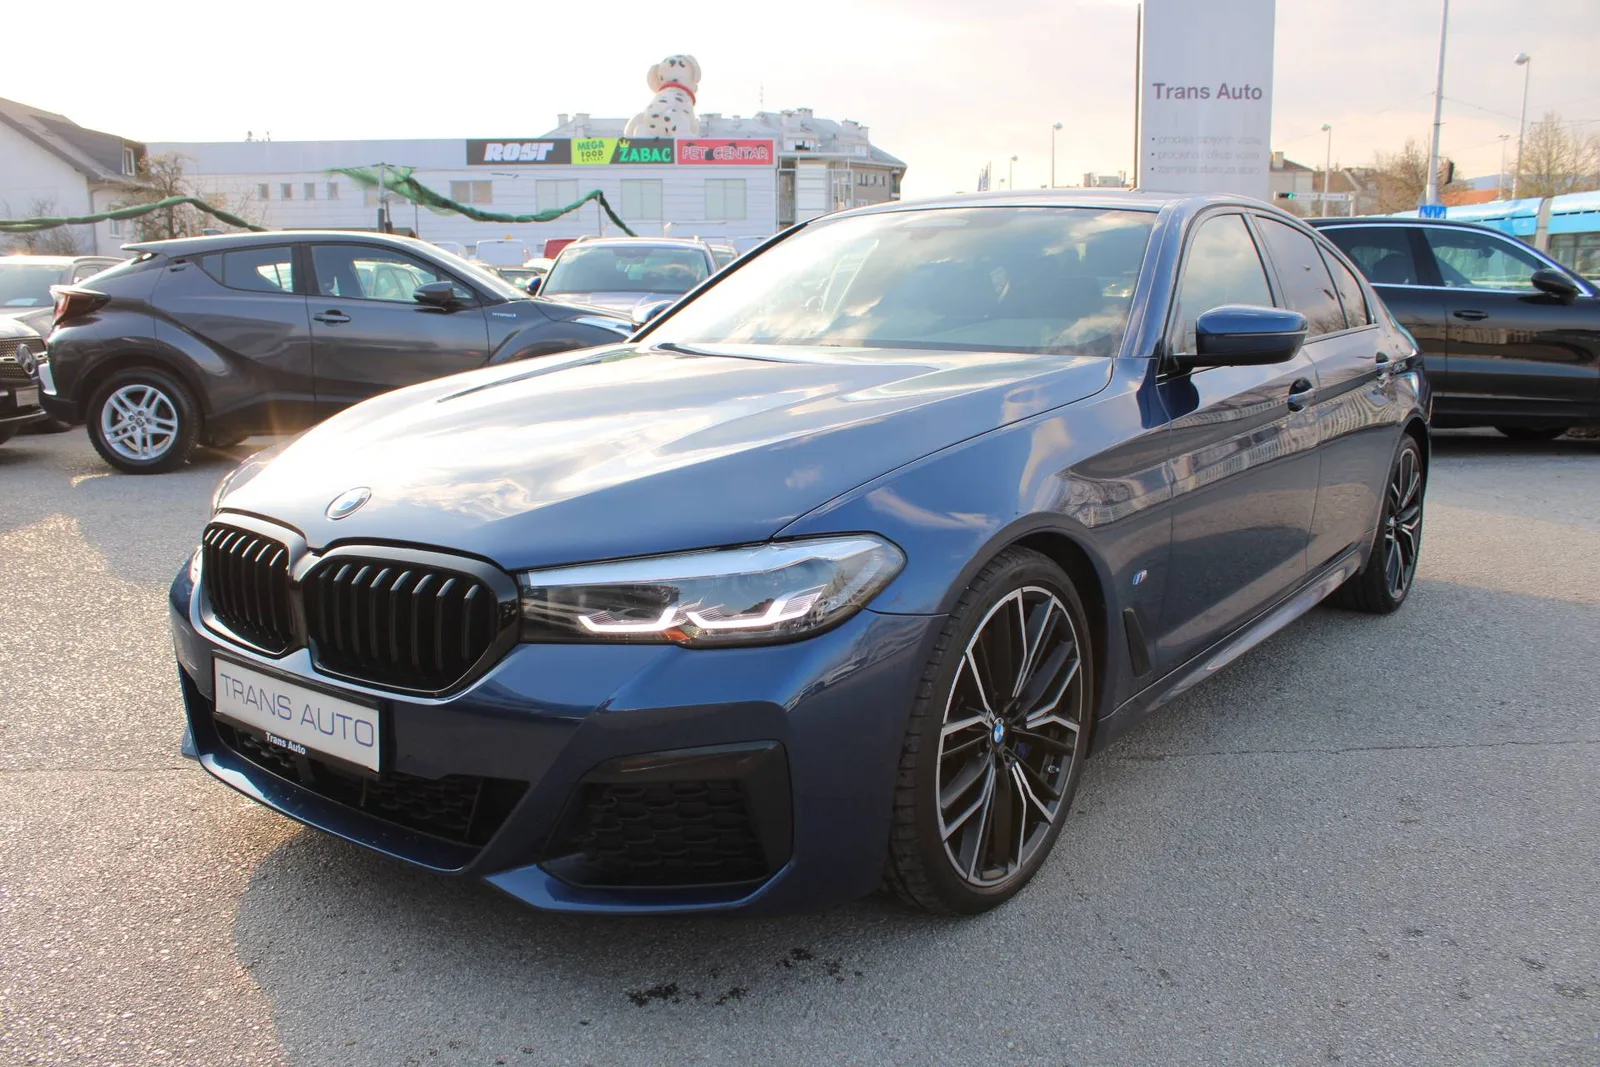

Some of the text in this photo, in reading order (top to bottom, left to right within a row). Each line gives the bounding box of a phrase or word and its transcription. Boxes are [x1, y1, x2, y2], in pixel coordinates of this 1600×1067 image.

[1152, 83, 1263, 100] Trans Auto
[484, 142, 554, 161] ROST
[577, 140, 604, 151] MEGA
[682, 146, 768, 160] PET CENTAR
[581, 150, 604, 159] FOOD
[220, 673, 375, 748] TRANS AUTO
[265, 731, 306, 755] Trans Auto
